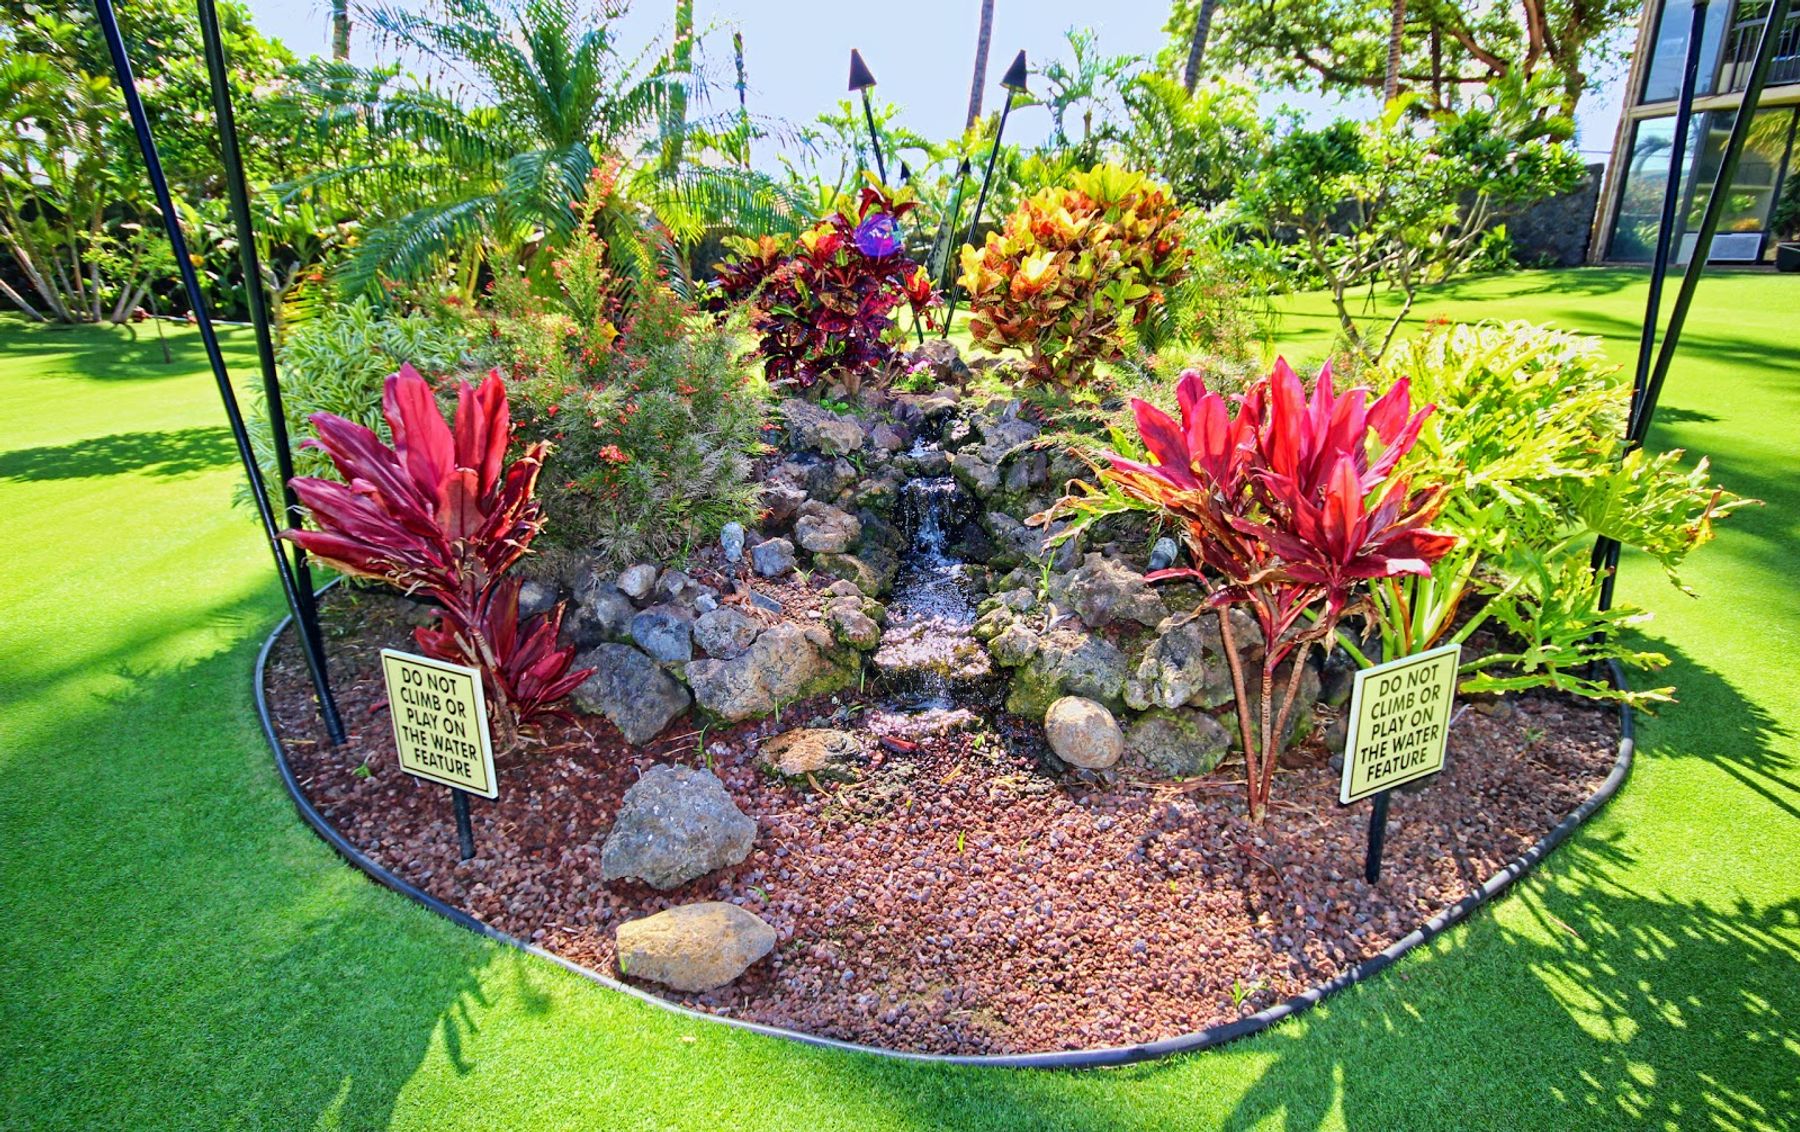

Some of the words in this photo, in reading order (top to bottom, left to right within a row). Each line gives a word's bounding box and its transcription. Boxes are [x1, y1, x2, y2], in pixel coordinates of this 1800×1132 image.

[402, 667, 422, 686] DO
[427, 674, 456, 695] NOT
[1379, 676, 1402, 697] DO
[1407, 665, 1439, 688] NOT
[400, 687, 441, 710] CLIMB
[446, 699, 466, 718] OR
[1371, 692, 1414, 720] CLIMB
[1421, 684, 1440, 704] OR
[407, 708, 437, 730] PLAY
[444, 718, 465, 738] ON
[1371, 715, 1407, 740] PLAY
[1411, 706, 1434, 726] ON
[402, 726, 427, 746] THE
[431, 733, 477, 761] WATER
[1361, 741, 1388, 764] THE
[1393, 725, 1439, 753] WATER
[414, 748, 471, 778] FEATURE
[1367, 748, 1427, 782] FEATURE
